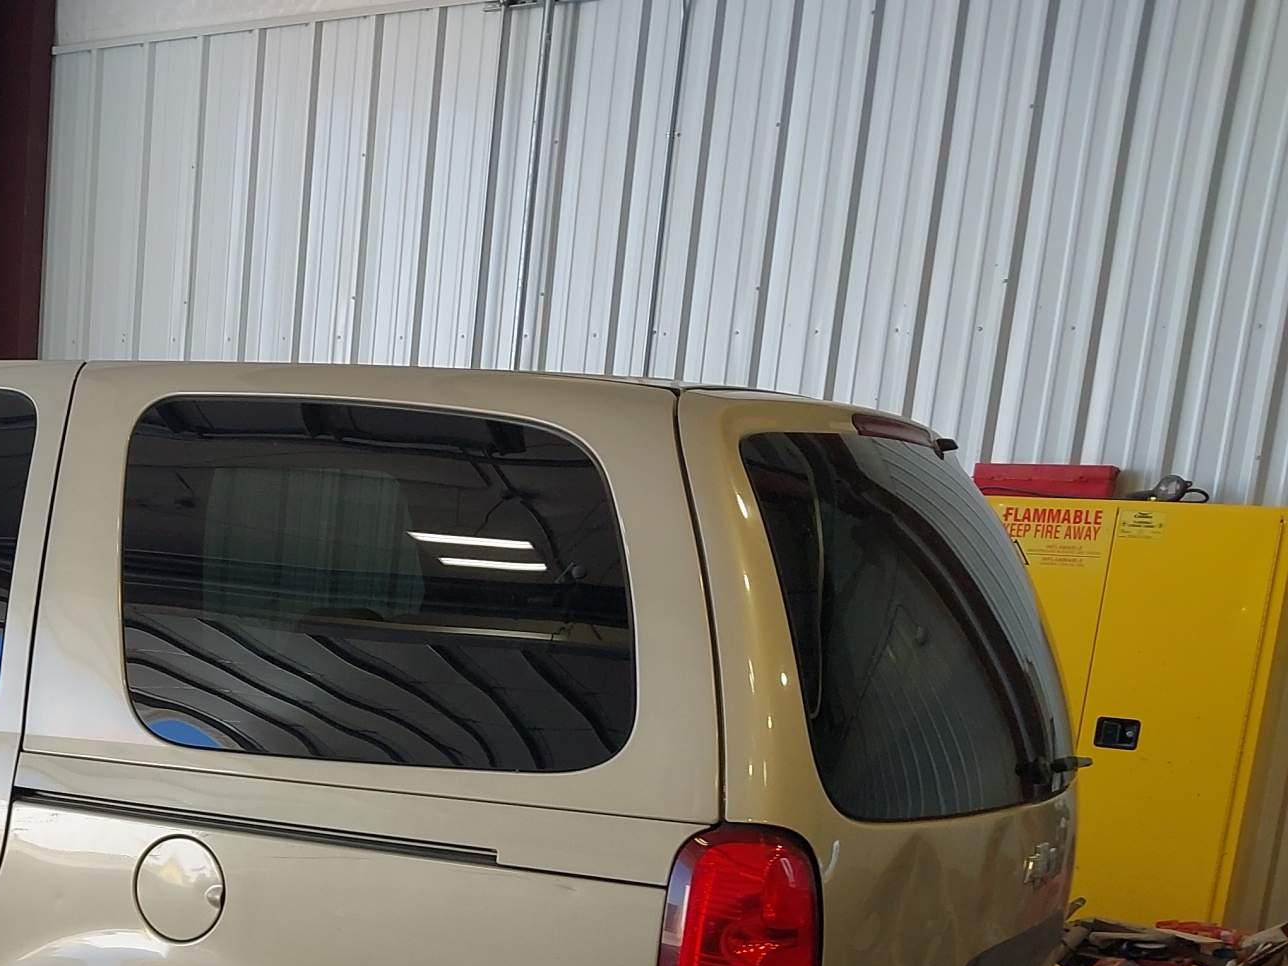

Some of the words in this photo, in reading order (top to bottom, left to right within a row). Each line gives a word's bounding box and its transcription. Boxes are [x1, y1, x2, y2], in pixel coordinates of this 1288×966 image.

[1003, 507, 1103, 525] FLAMMABLE
[1034, 523, 1061, 539] FIRE
[1064, 525, 1101, 541] AWAY
